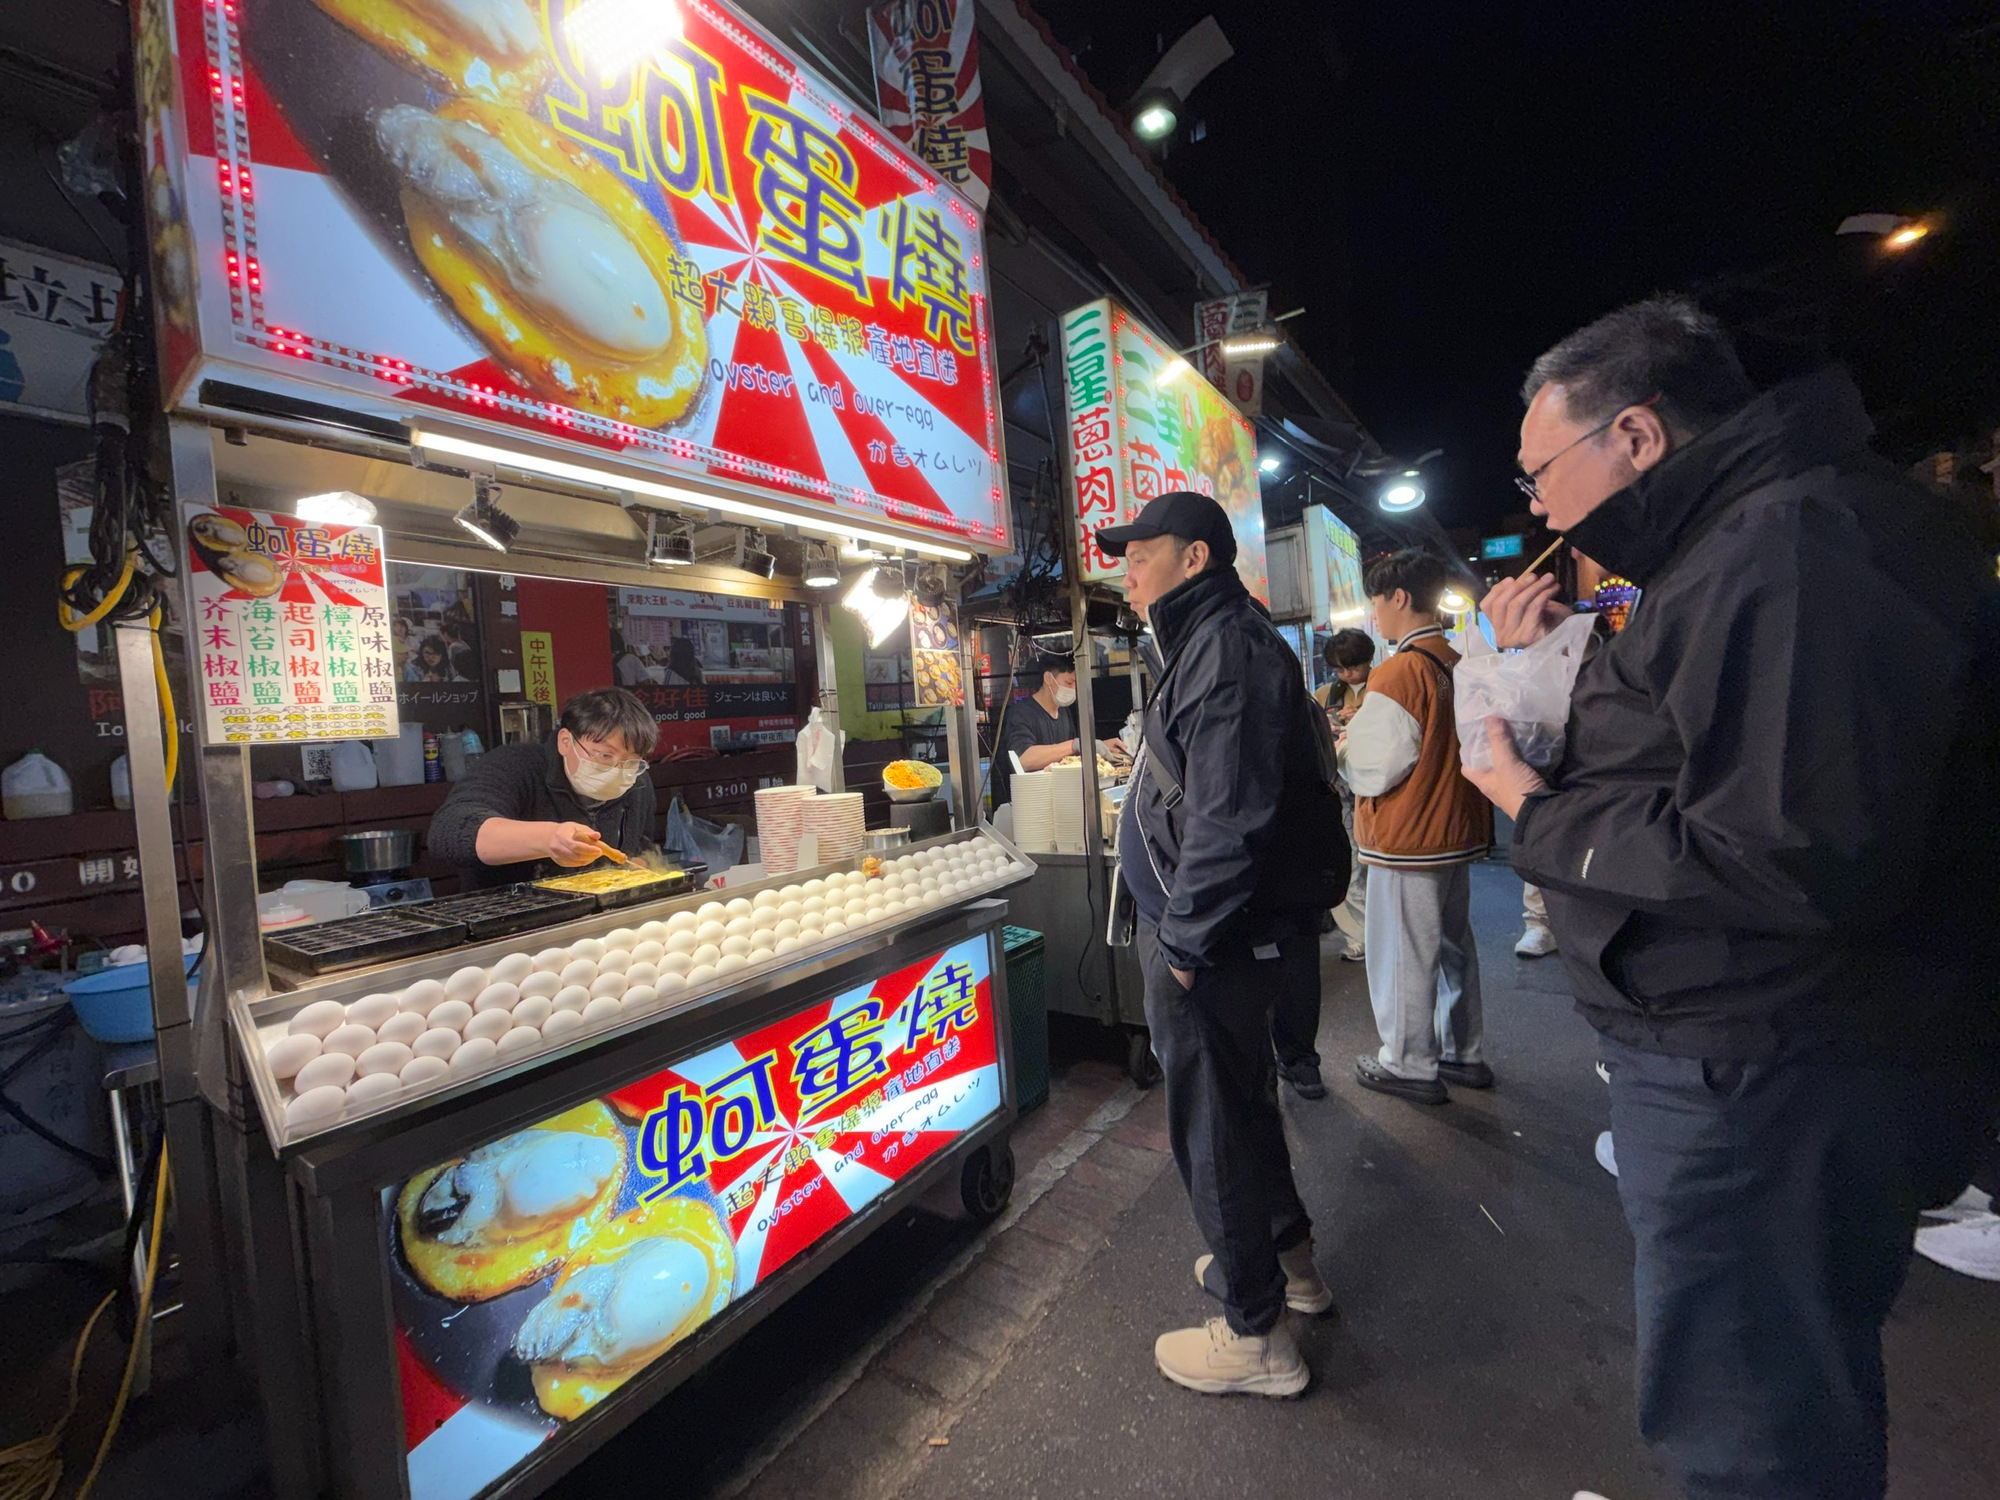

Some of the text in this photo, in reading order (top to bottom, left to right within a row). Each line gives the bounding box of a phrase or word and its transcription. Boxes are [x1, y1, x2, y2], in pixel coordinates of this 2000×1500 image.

[711, 358, 934, 431] oyster and over-egg
[247, 522, 377, 564] 蚵蛋燒
[199, 596, 243, 706] 芥末椒鹽
[242, 599, 284, 705] 海苔椒鹽
[283, 602, 323, 704] 起司椒鹽
[323, 604, 360, 704] 檸檬椒鹽
[360, 606, 396, 703] 原味椒鹽
[530, 638, 550, 703] 中午以後
[399, 690, 479, 704] ホイールショップ
[655, 710, 706, 723] good good
[714, 690, 788, 702] ジェーンは良いよ
[706, 783, 748, 799] 13:00
[637, 961, 980, 1211] 蚵蛋燒
[757, 1088, 939, 1232] oyster and over-egg
